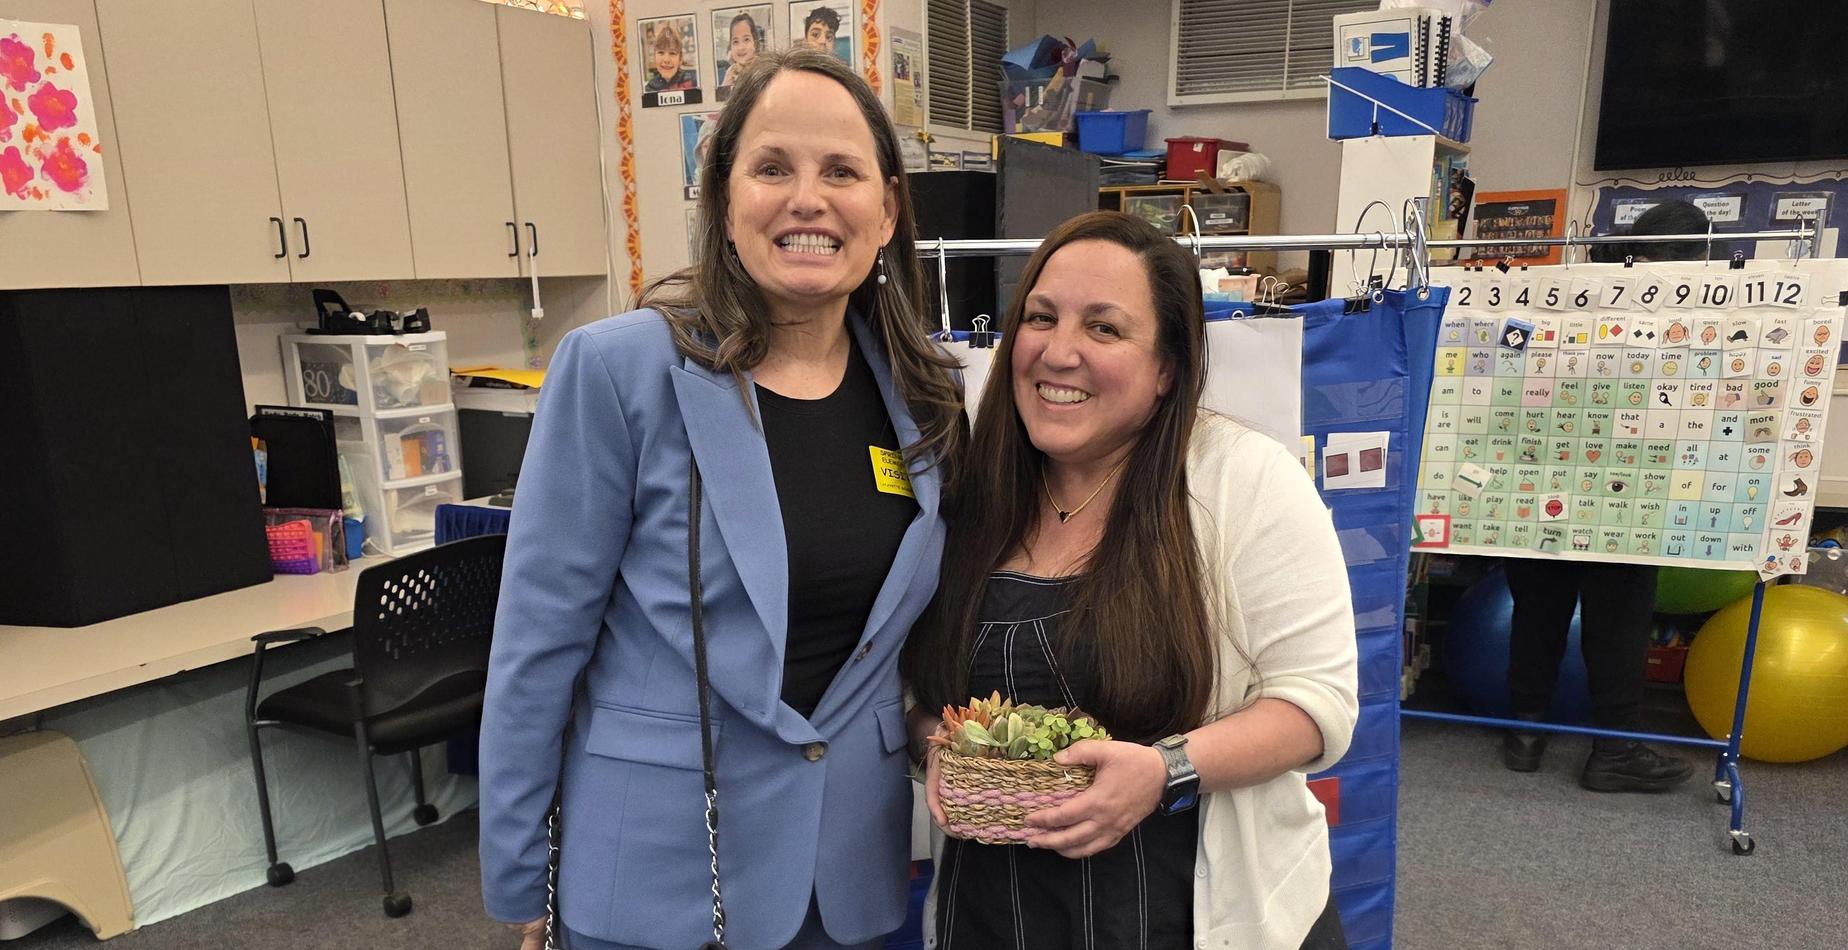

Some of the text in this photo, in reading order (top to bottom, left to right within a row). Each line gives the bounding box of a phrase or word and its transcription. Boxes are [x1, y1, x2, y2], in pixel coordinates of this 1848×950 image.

[1702, 201, 1730, 209] Question
[1458, 287, 1471, 306] 2
[1488, 287, 1500, 306] 3
[1516, 287, 1530, 306] 4
[1610, 286, 1625, 305] 7
[1641, 285, 1659, 304] 8
[1675, 284, 1691, 305] 9
[1702, 283, 1728, 306] 10
[1745, 281, 1765, 304] 11
[1773, 281, 1801, 305] 12
[1545, 288, 1560, 306] 5
[1575, 289, 1589, 307] 6
[1472, 351, 1489, 359] who
[1500, 351, 1521, 360] again
[1531, 351, 1552, 359] please
[1627, 351, 1650, 360] today
[1661, 352, 1682, 360] time
[303, 370, 330, 397] 80
[1561, 382, 1578, 390] feel
[1592, 382, 1611, 391] give
[1656, 383, 1678, 391] okay
[1689, 383, 1712, 391] tired
[1754, 380, 1779, 390] good
[1501, 388, 1512, 396] be
[1726, 384, 1743, 392] bad
[1526, 388, 1550, 398] really
[1441, 411, 1449, 419] is
[1526, 411, 1544, 419] hurt
[1556, 411, 1576, 419] hear
[1620, 413, 1640, 421] that
[1721, 415, 1738, 423] and
[1750, 415, 1774, 424] more
[1687, 421, 1704, 429] the
[1465, 438, 1478, 446] eat
[1491, 438, 1512, 446] drink
[1521, 437, 1542, 446] finish
[1555, 441, 1570, 450] get
[1585, 442, 1603, 450] love
[1616, 442, 1638, 450] make
[1647, 444, 1670, 452] need
[1686, 444, 1698, 452] all
[1490, 467, 1508, 476] help
[1519, 469, 1539, 477] open
[1552, 470, 1567, 478] put
[1433, 472, 1444, 480] do
[1644, 473, 1666, 481] show
[1681, 481, 1693, 490] of
[1748, 478, 1760, 486] on
[1712, 483, 1727, 491] for
[1427, 493, 1446, 501] have
[1486, 496, 1504, 505] play
[1578, 499, 1595, 507] talk
[1640, 503, 1660, 511] wish
[1679, 504, 1687, 512] in
[1710, 507, 1720, 516] up
[1742, 508, 1757, 516] off
[1453, 522, 1472, 530] want
[1482, 524, 1501, 532] take
[1543, 526, 1562, 537] turn
[1604, 530, 1625, 538] wear
[1635, 532, 1657, 540] work
[1670, 534, 1686, 542] out
[1700, 535, 1722, 543] down
[1732, 544, 1754, 552] with
